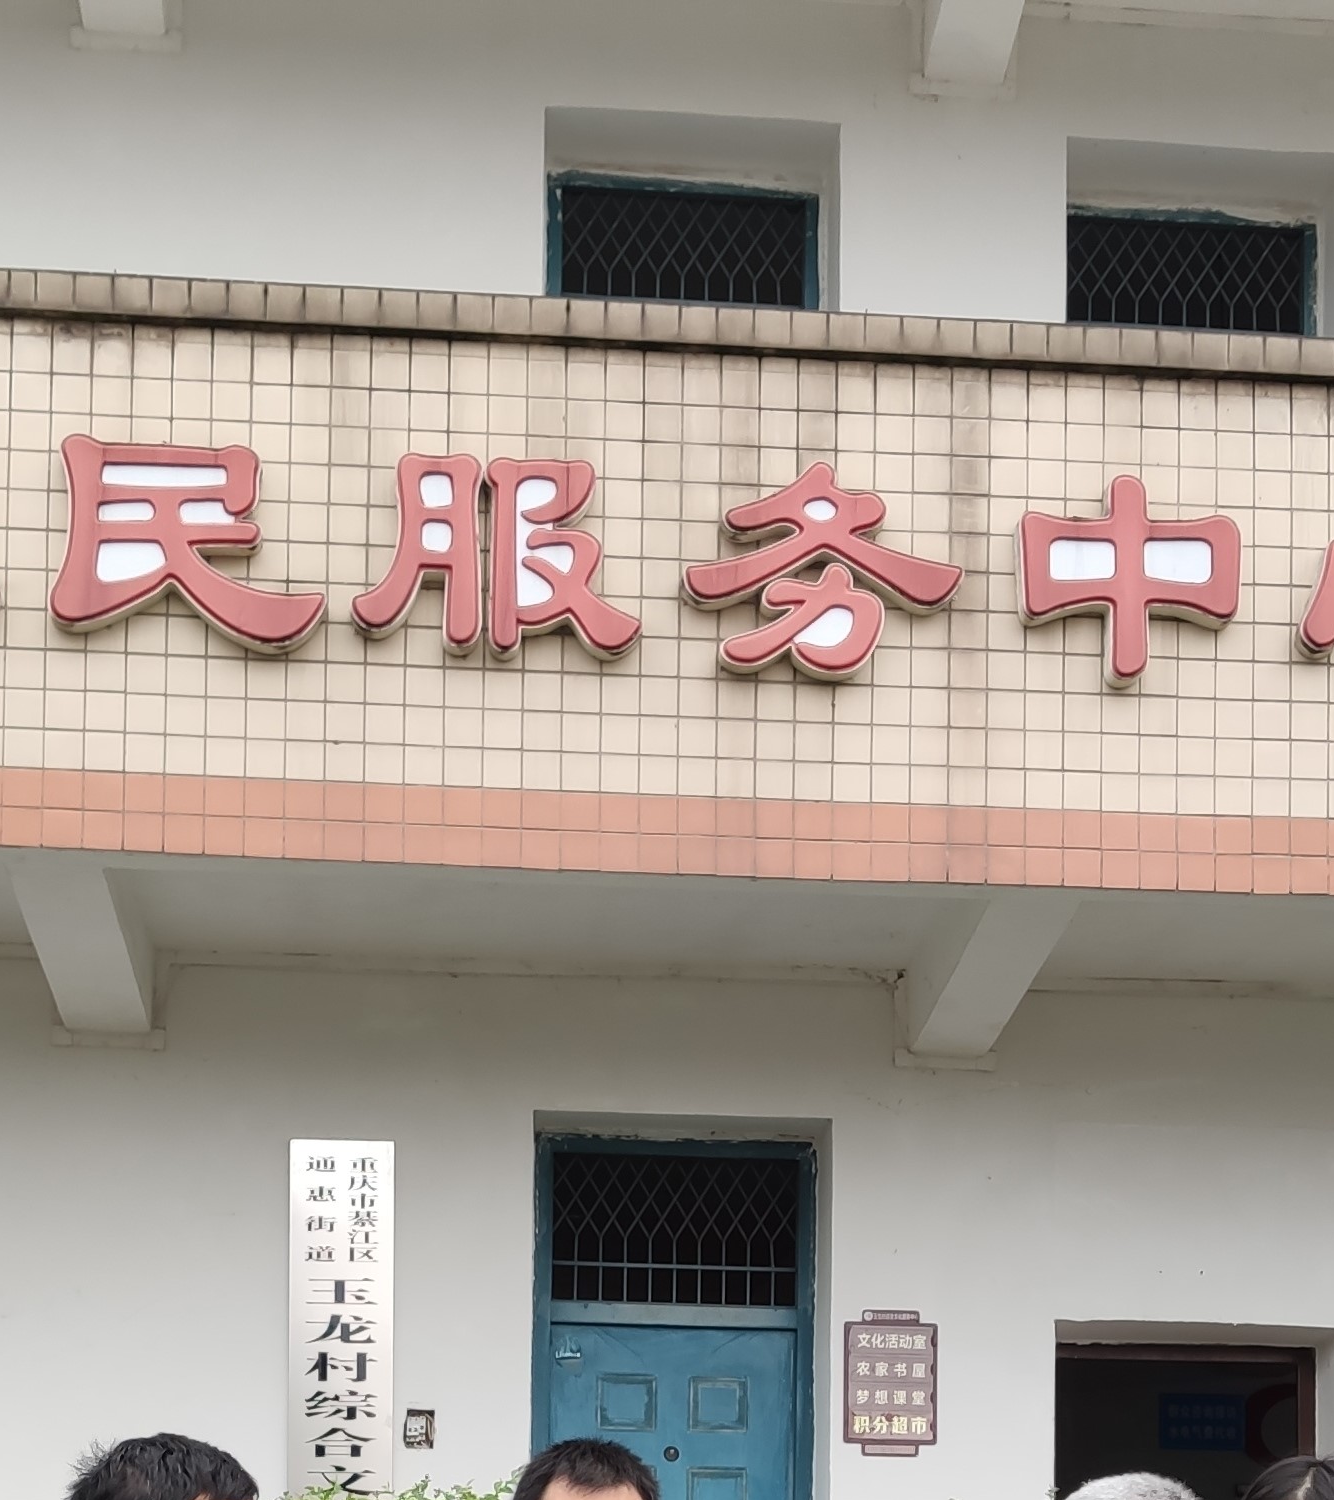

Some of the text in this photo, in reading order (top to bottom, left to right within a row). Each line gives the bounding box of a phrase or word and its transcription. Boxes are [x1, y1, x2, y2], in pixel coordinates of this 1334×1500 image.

[304, 1155, 337, 1263] 通惠街道
[347, 1156, 379, 1263] 重庆市綦江区
[857, 1332, 927, 1350] 文化活动室
[856, 1362, 926, 1378] 农家书屋
[856, 1389, 926, 1405] 梦想课堂
[853, 1416, 927, 1435] 积分超市
